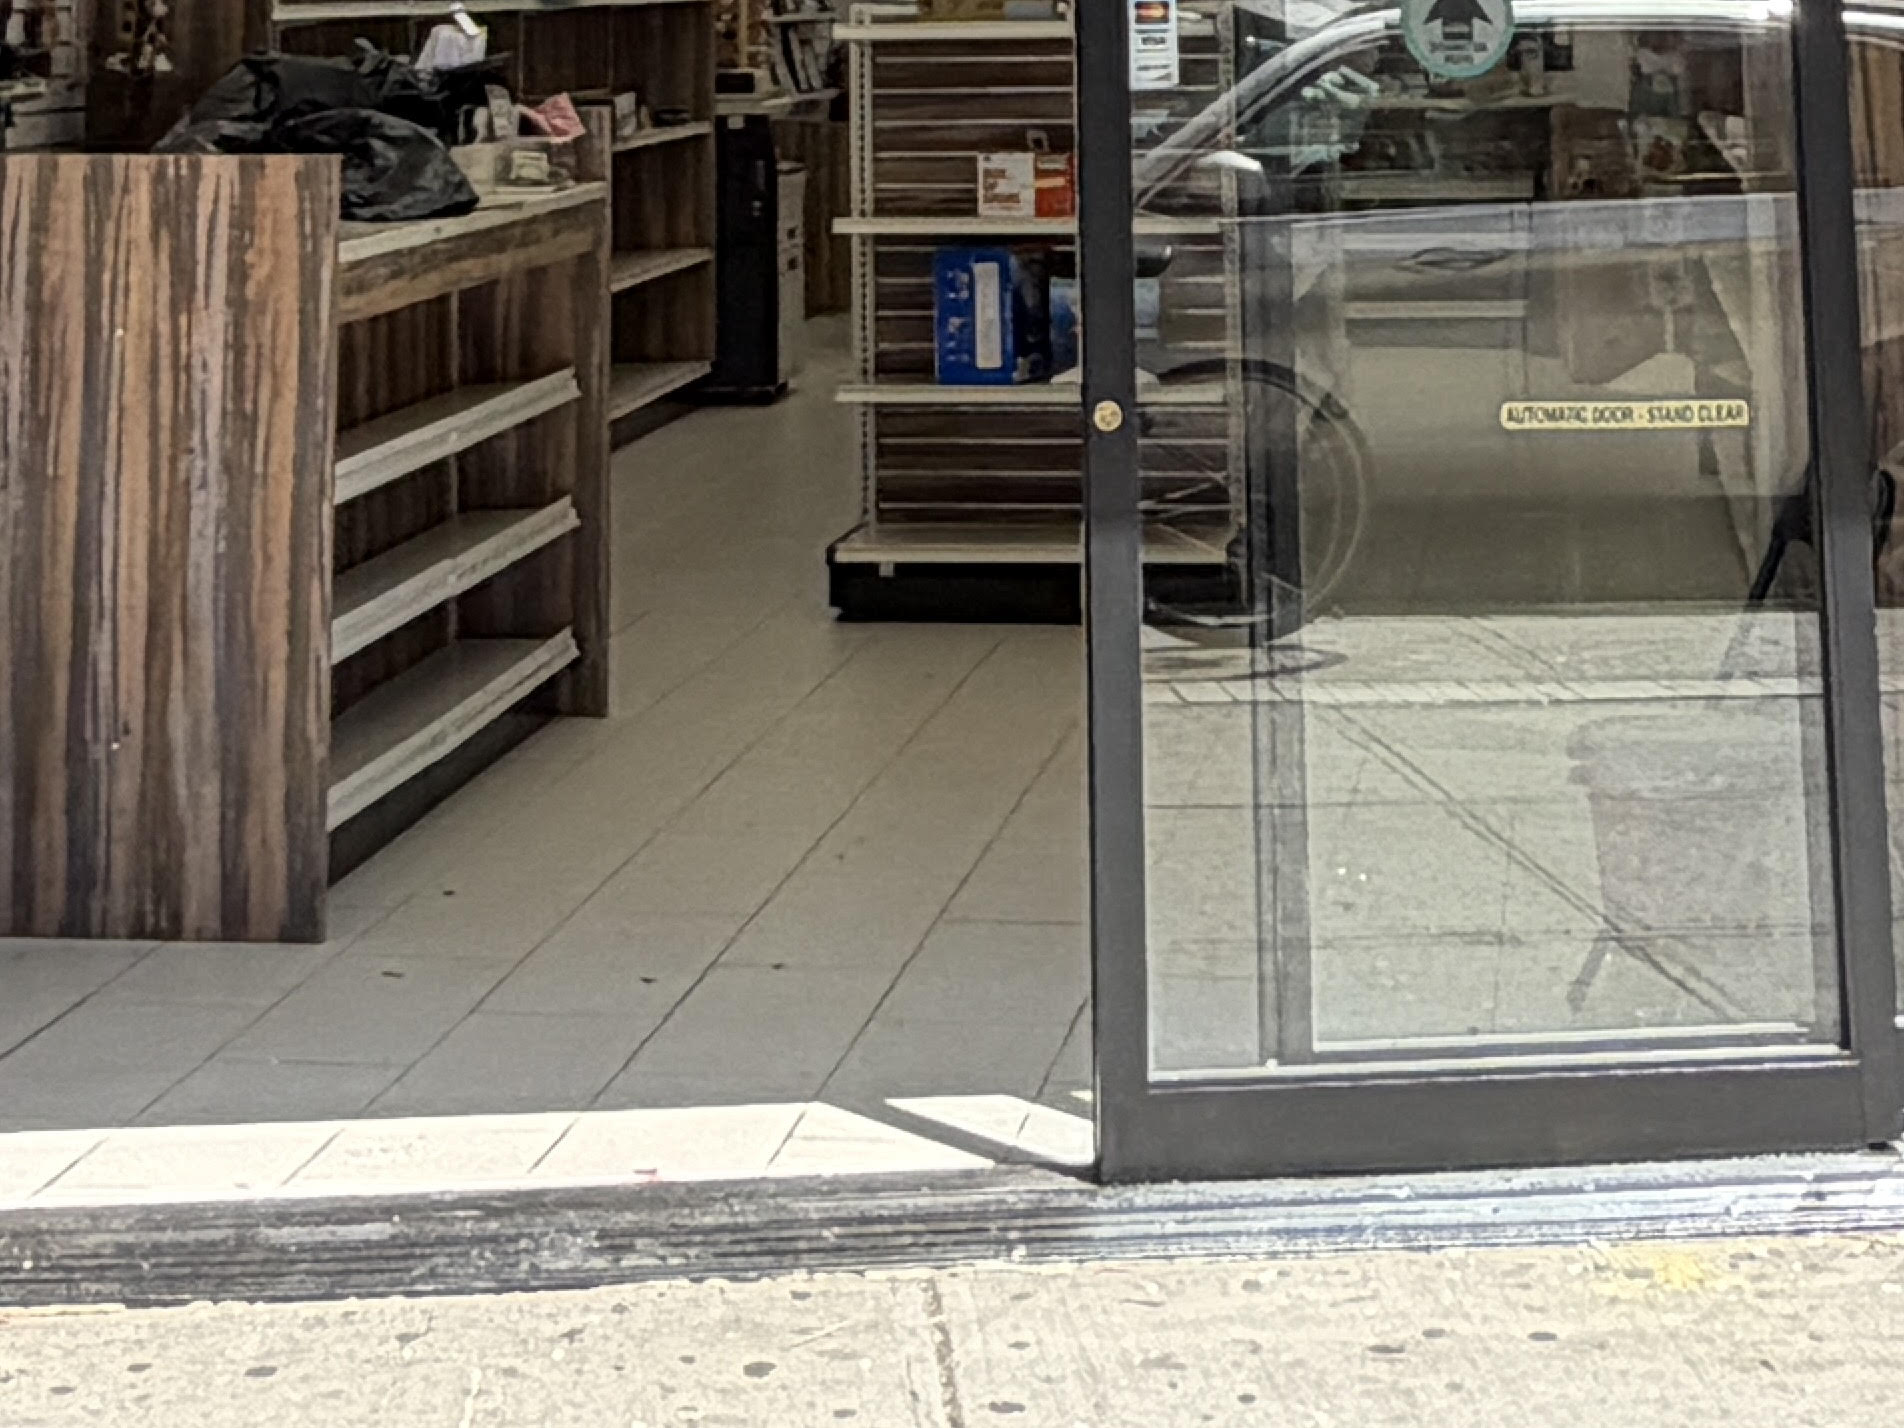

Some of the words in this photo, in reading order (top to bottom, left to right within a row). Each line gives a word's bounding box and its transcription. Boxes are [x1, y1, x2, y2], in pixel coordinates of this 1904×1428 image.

[1506, 406, 1588, 424] AUTOMATIC
[1592, 406, 1634, 423] DOOR
[1646, 405, 1695, 423] STAND
